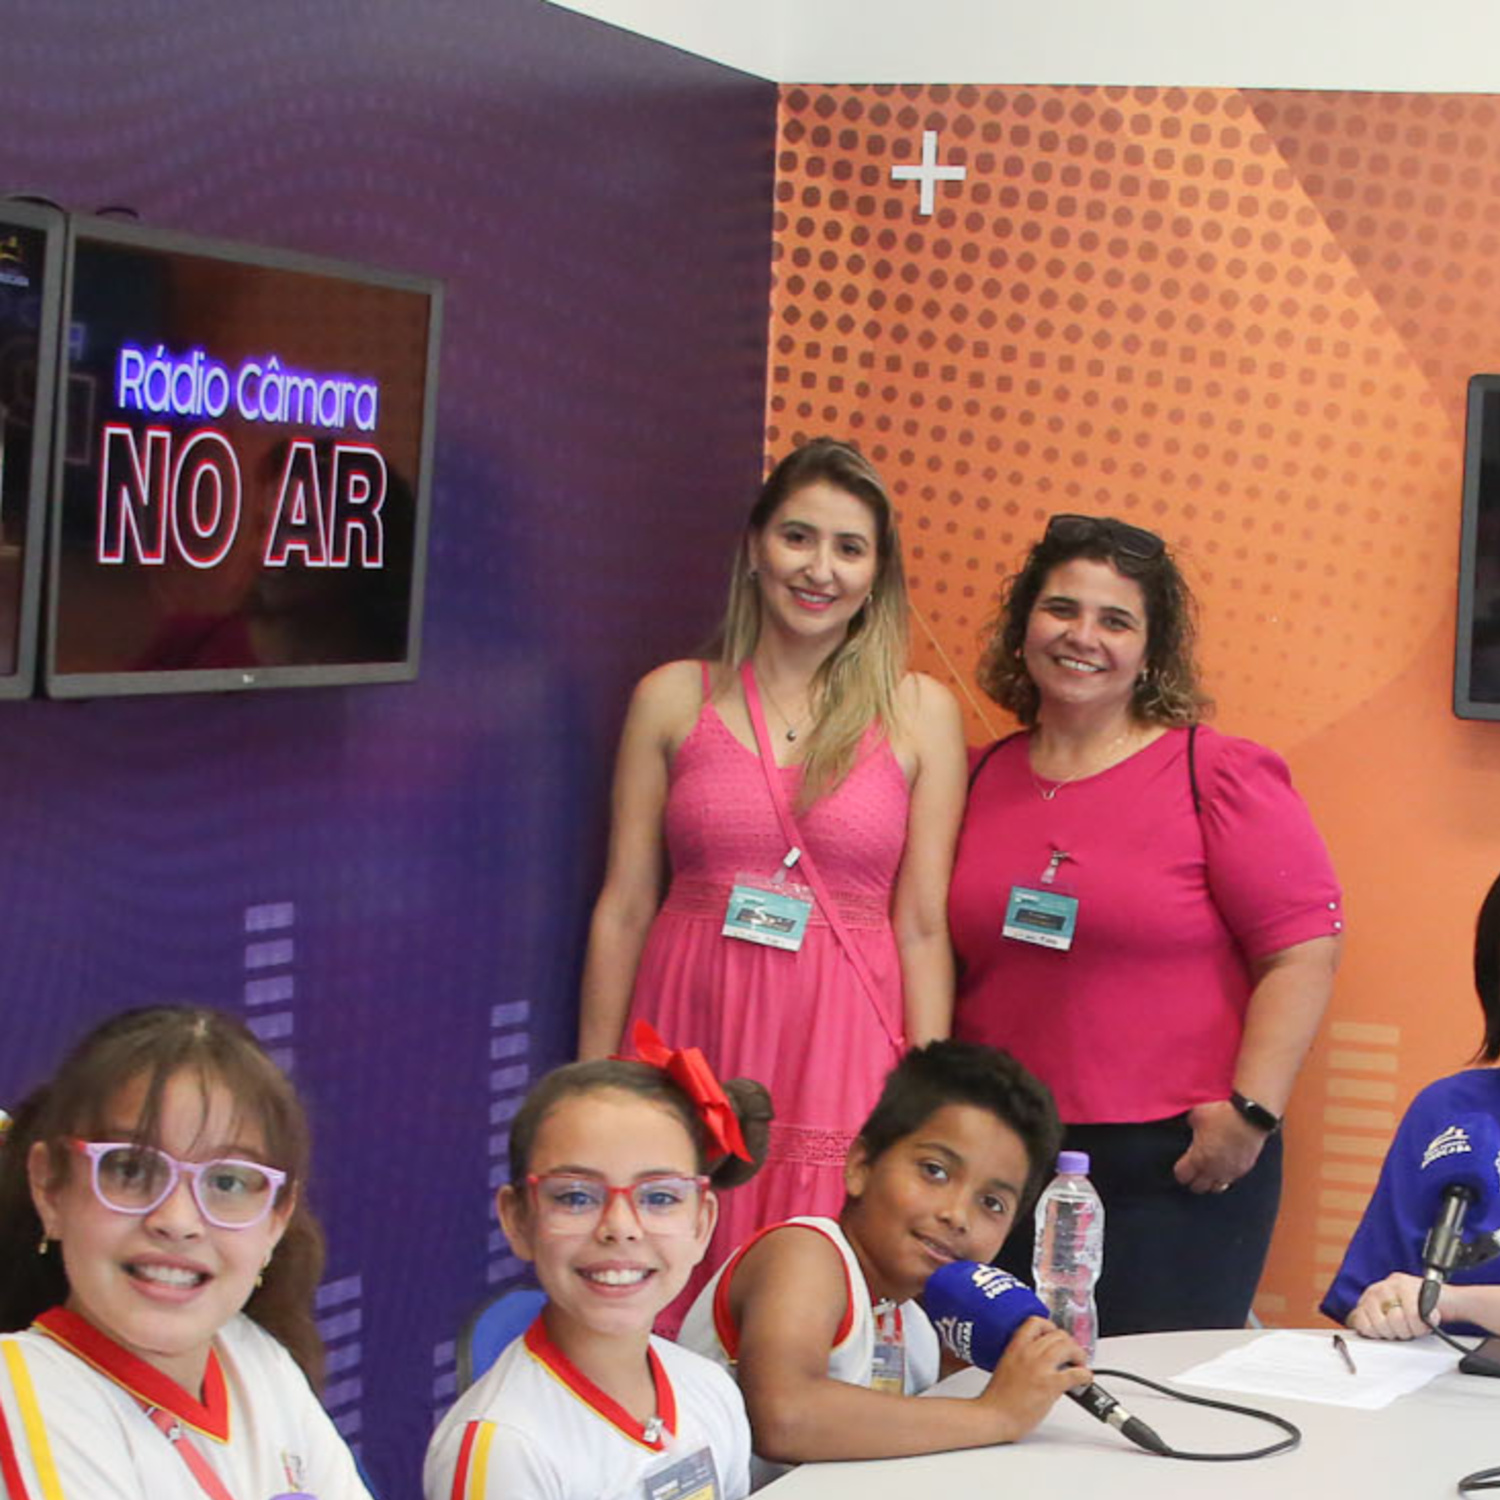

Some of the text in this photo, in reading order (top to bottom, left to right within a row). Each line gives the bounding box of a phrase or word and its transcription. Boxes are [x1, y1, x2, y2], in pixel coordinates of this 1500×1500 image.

[118, 345, 378, 431] Rádio Câmara
[99, 423, 388, 569] NO AR
